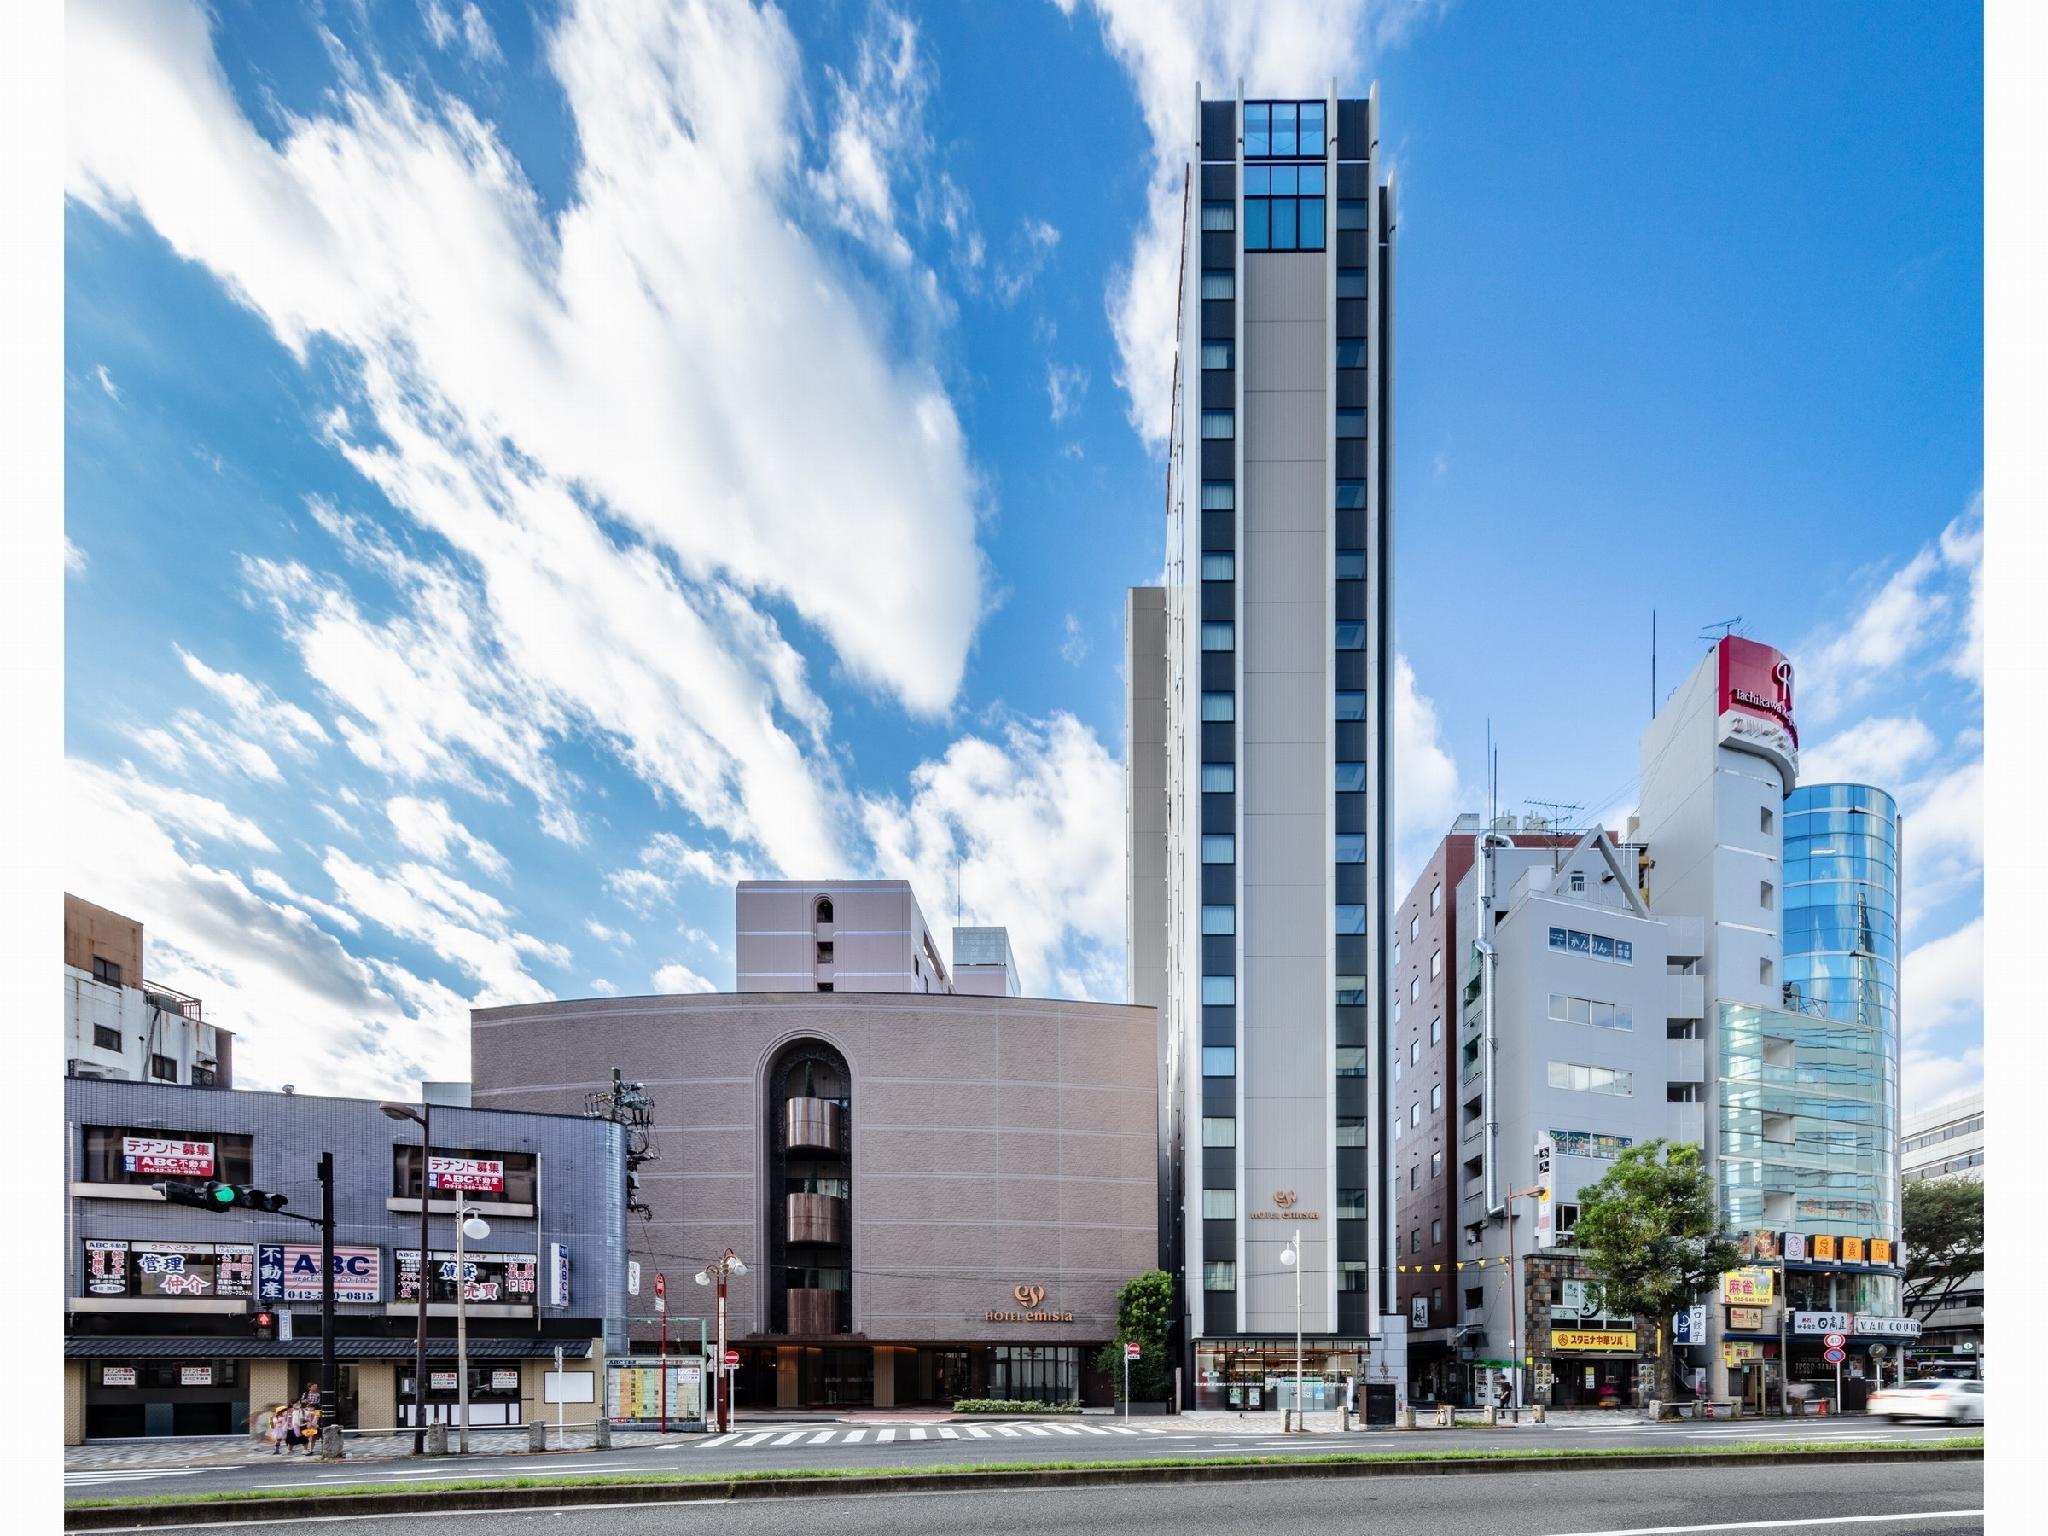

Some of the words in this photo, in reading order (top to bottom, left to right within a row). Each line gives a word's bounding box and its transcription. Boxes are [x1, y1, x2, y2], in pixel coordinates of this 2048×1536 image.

[128, 1140, 209, 1156] テナント募集
[432, 1159, 499, 1173] テナント募集
[139, 1254, 184, 1273] 管理
[261, 1247, 282, 1298] 不動産
[163, 1274, 210, 1295] 仲介
[1730, 1280, 1754, 1294] 麻雀
[287, 1290, 375, 1301] 042-50-0815
[985, 1311, 1021, 1321] HOTEL
[1025, 1311, 1073, 1322] emisia
[1570, 1335, 1623, 1346] スタミナ中華ソバ
